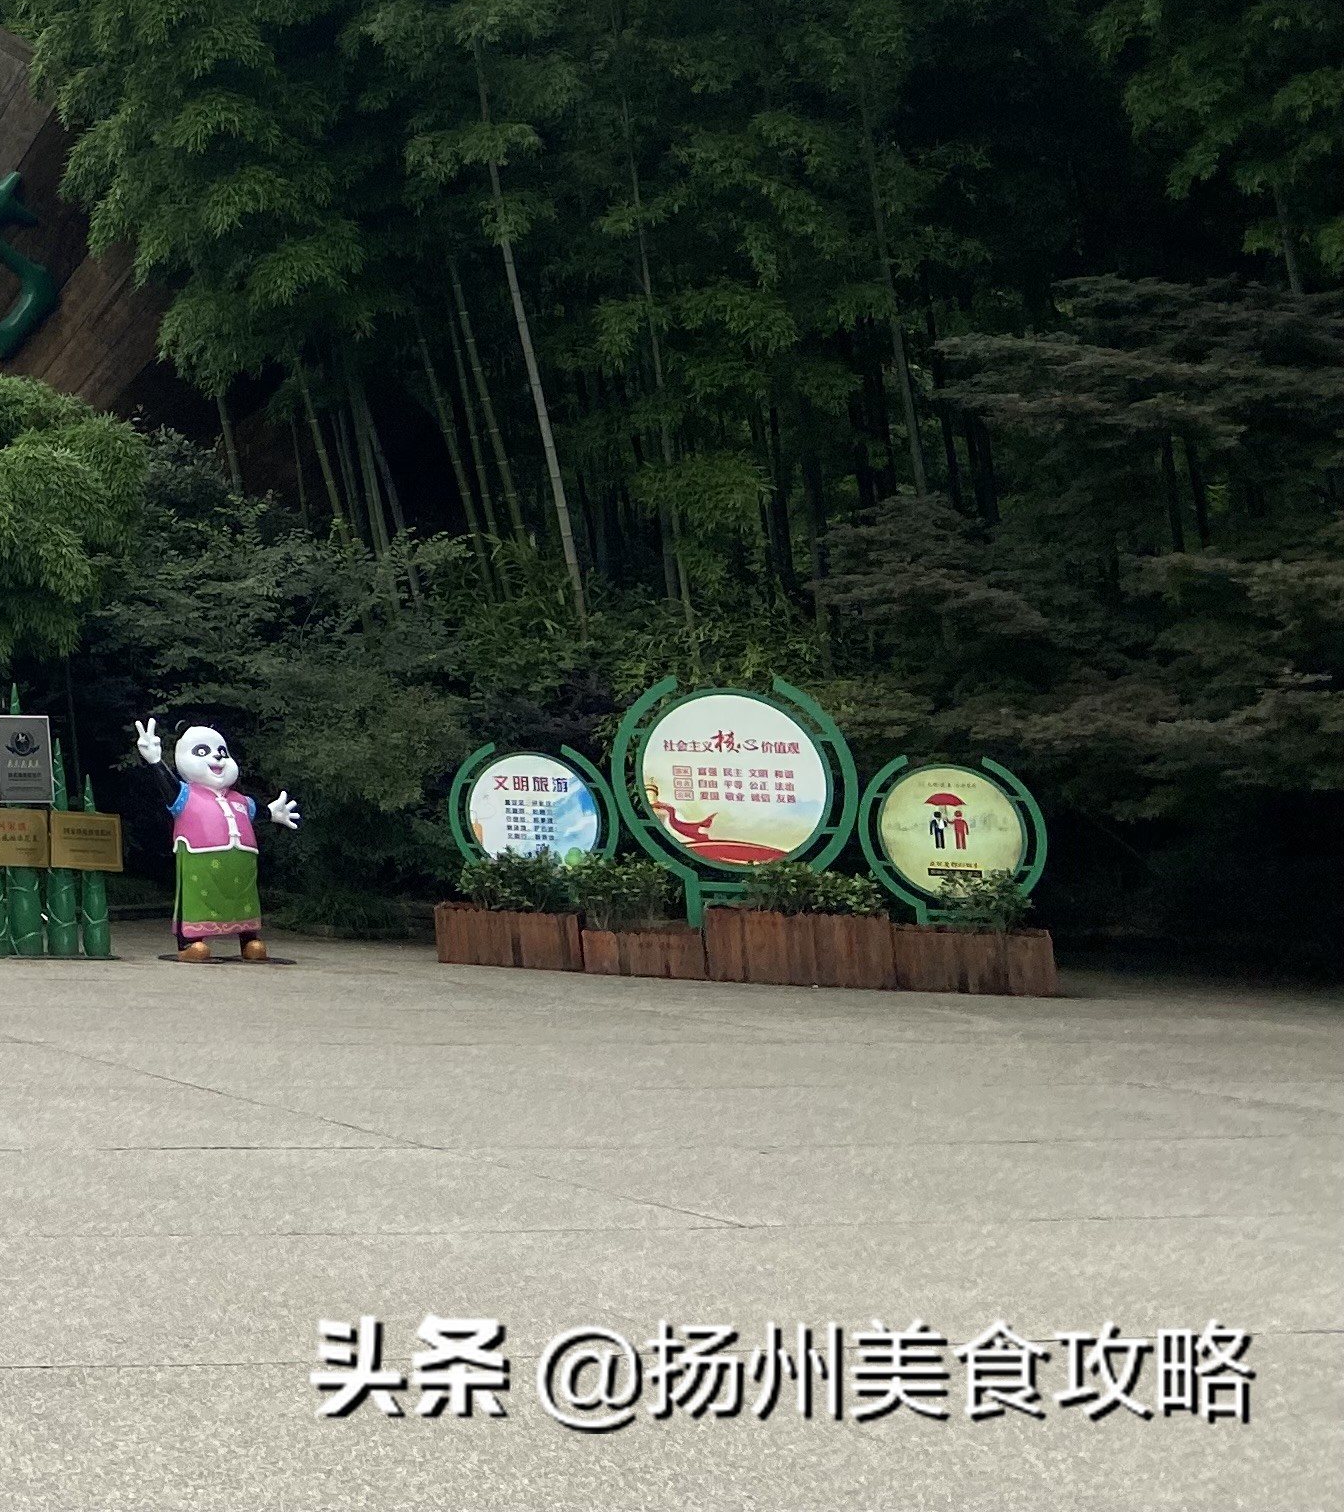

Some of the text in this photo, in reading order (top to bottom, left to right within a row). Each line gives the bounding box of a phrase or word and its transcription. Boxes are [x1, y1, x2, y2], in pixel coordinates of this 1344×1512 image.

[663, 729, 800, 754] 社会主义核心价值观
[492, 775, 569, 793] 文明旅游
